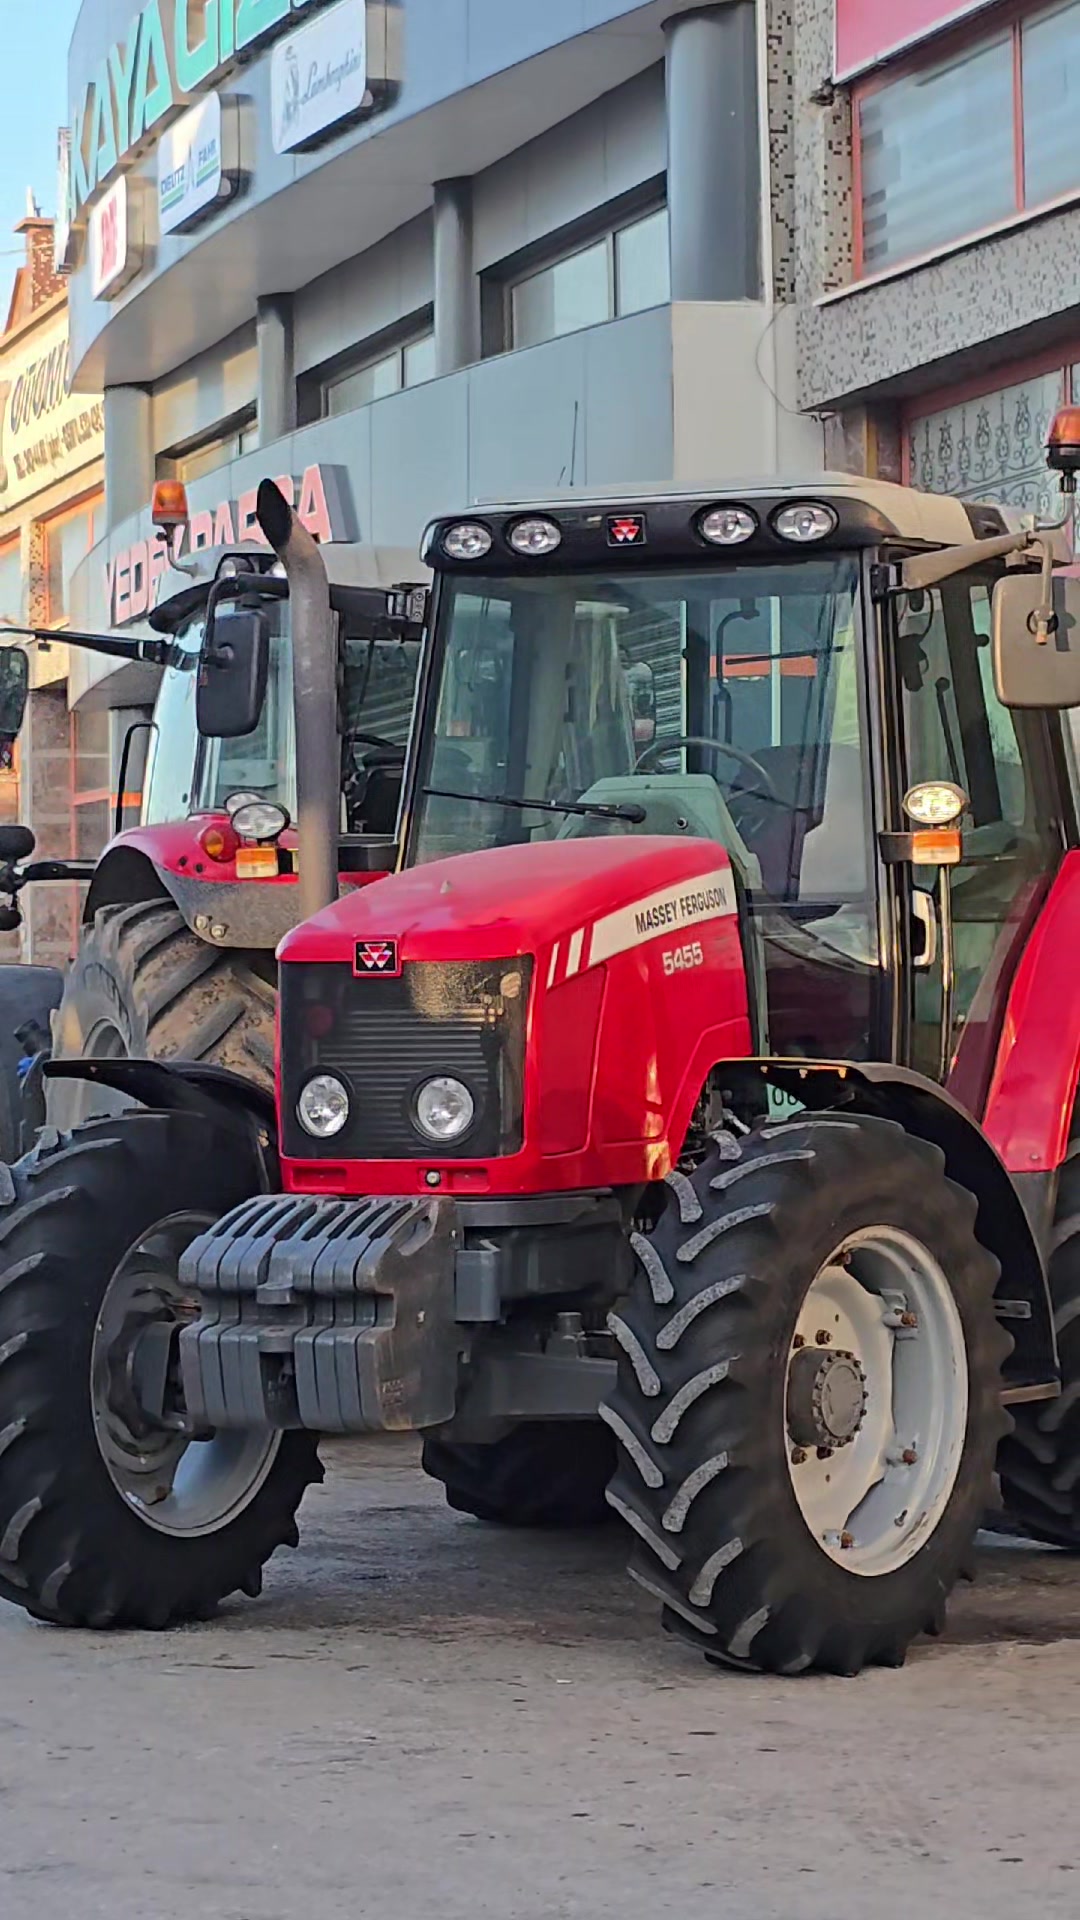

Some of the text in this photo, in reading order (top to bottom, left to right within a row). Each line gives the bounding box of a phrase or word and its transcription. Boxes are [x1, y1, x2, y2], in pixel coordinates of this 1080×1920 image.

[161, 165, 185, 195] DEUTZ
[635, 887, 727, 934] MASSEY FERGUSON
[662, 941, 703, 976] 5455
